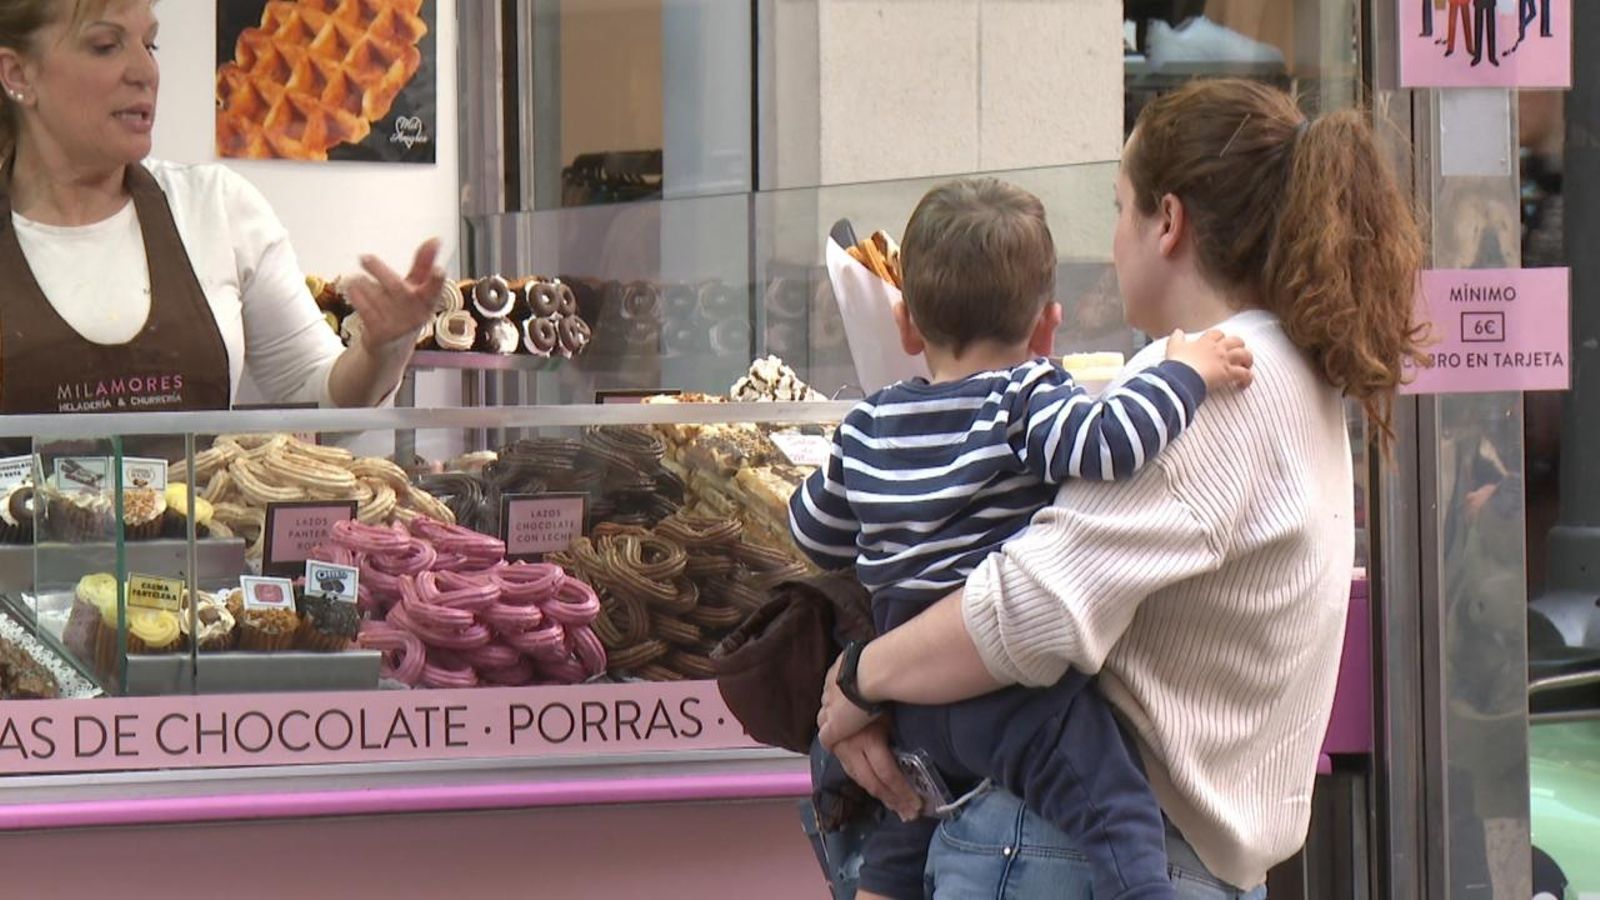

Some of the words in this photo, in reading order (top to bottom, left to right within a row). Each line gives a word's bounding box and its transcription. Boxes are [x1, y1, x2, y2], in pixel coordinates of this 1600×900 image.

[1474, 319, 1496, 335] 6€
[1466, 352, 1489, 368] EN
[1494, 352, 1564, 367] TARJETA
[57, 375, 183, 399] MILAMORES
[288, 529, 331, 538] PANTER
[74, 714, 139, 758] DE
[155, 705, 468, 756] CHOCOLATE
[508, 697, 703, 745] PORRAS
